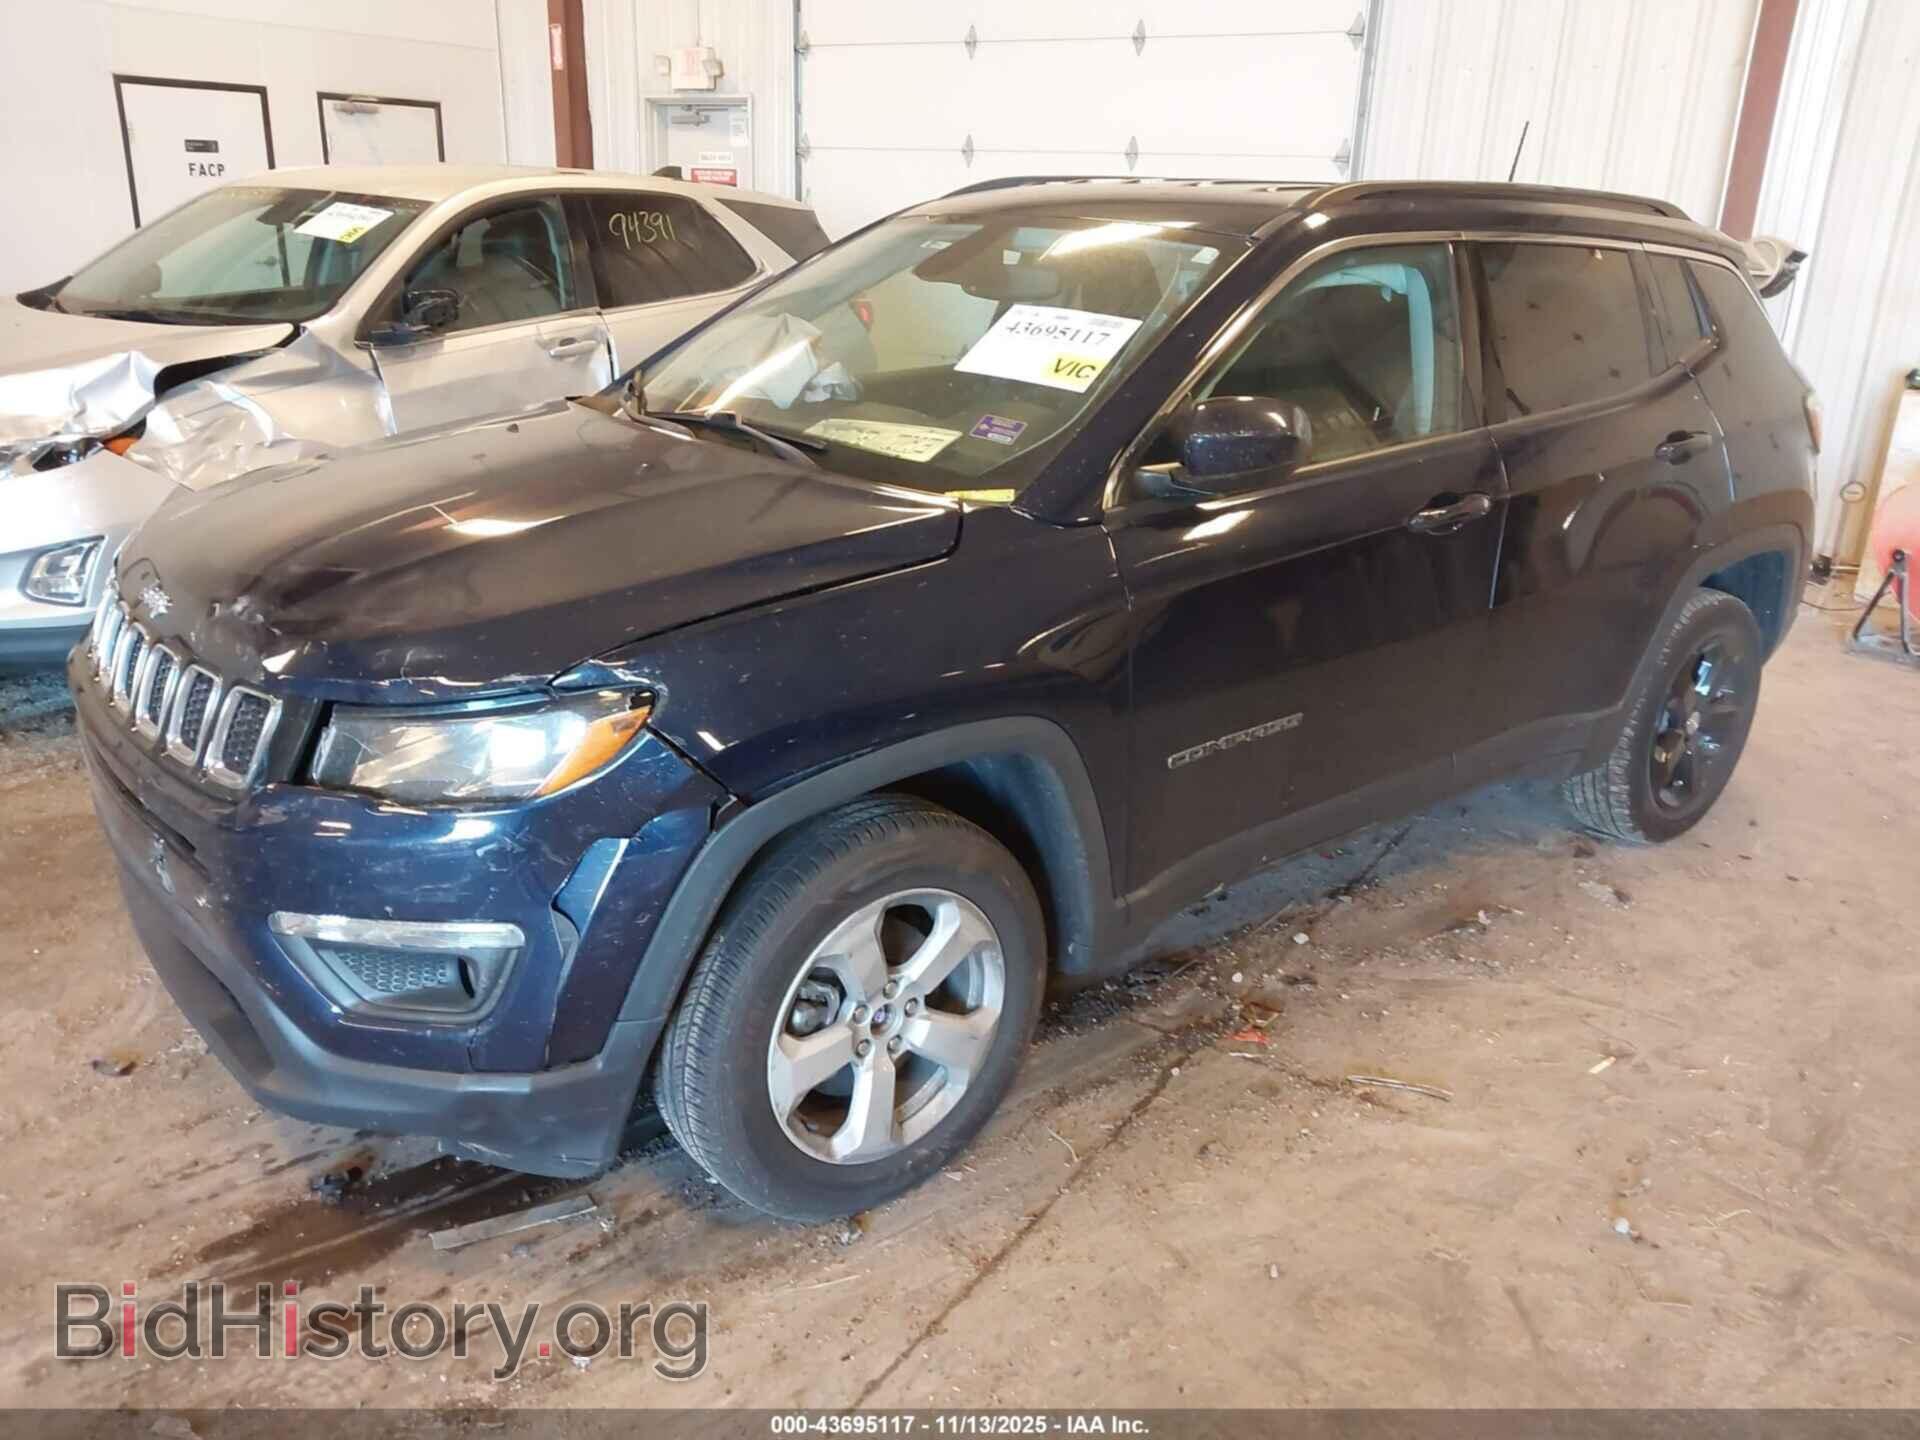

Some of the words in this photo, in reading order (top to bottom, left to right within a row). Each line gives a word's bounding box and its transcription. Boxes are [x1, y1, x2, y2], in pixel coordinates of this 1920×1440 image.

[188, 162, 225, 177] FACP
[608, 210, 676, 251] 94391
[1006, 319, 1112, 346] 43695117
[1053, 357, 1097, 380] VIC
